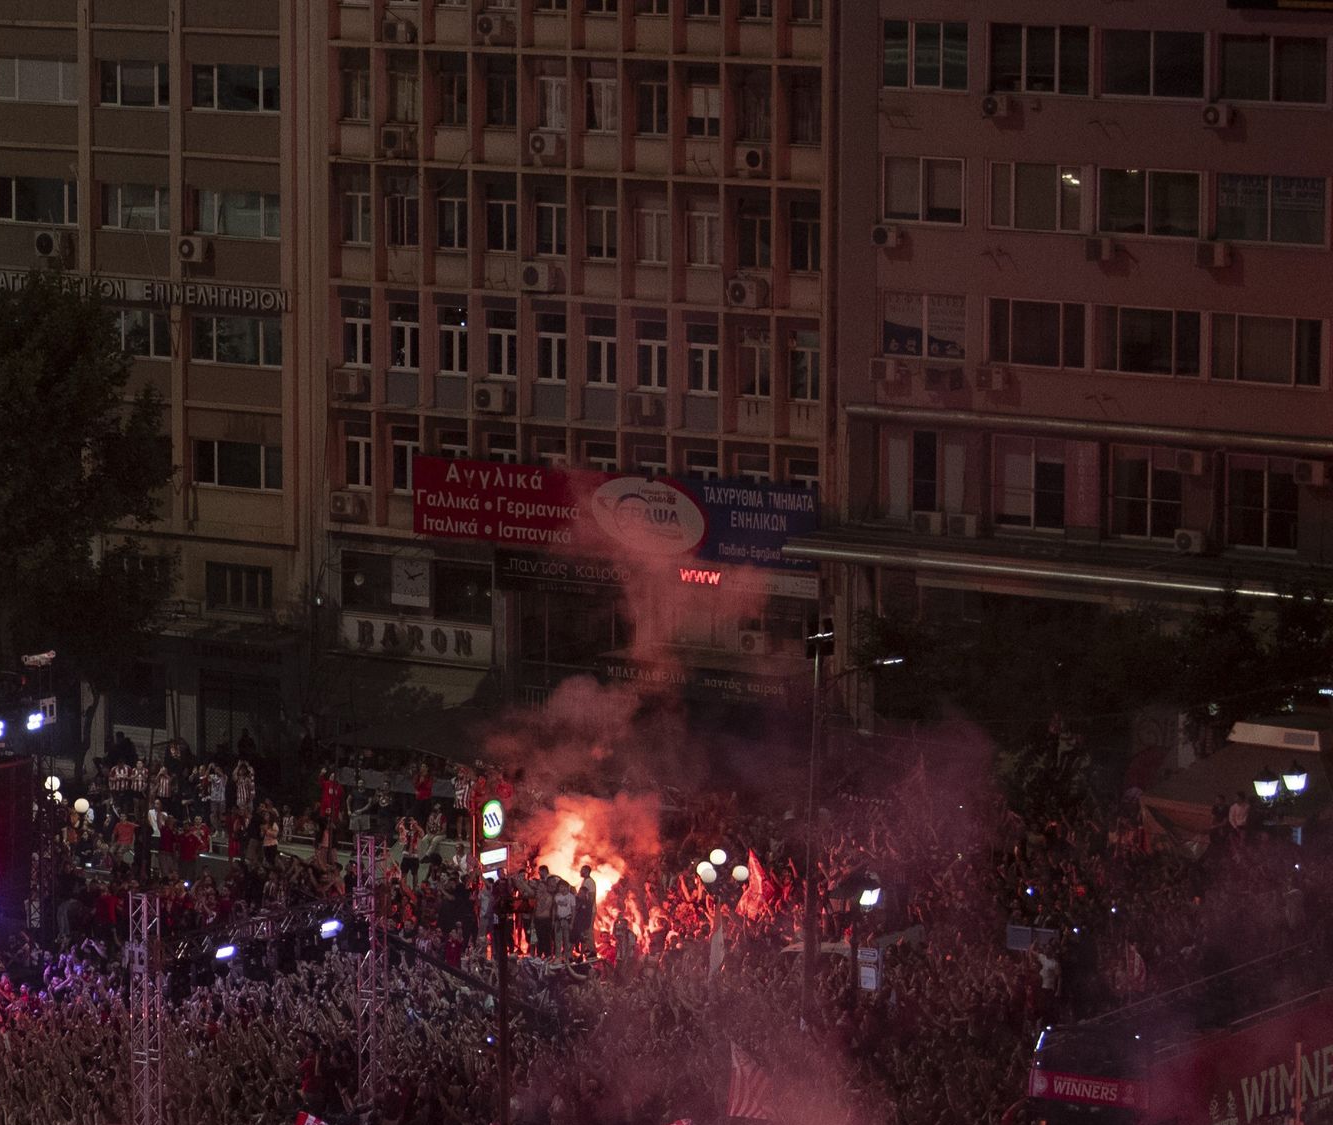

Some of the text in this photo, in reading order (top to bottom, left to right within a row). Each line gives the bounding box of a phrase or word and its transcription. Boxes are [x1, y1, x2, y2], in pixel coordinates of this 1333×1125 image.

[143, 282, 292, 313] ΕΠΙΜΕΛΗΤΗΡΙΟΝ
[445, 462, 543, 490] Αγγλικά
[416, 488, 581, 520] Γαλλικά Γερμανικά
[703, 486, 814, 513] ΤΑΧΥΡΥΘΜΑ ΤΜΗΜΑΤΑ
[423, 513, 572, 545] Ιταλικά Ισπανικά
[730, 510, 787, 532] ΕΝΗΛΙΚΩΝ
[356, 619, 474, 658] BARON
[1053, 1079, 1118, 1102] WINNERS
